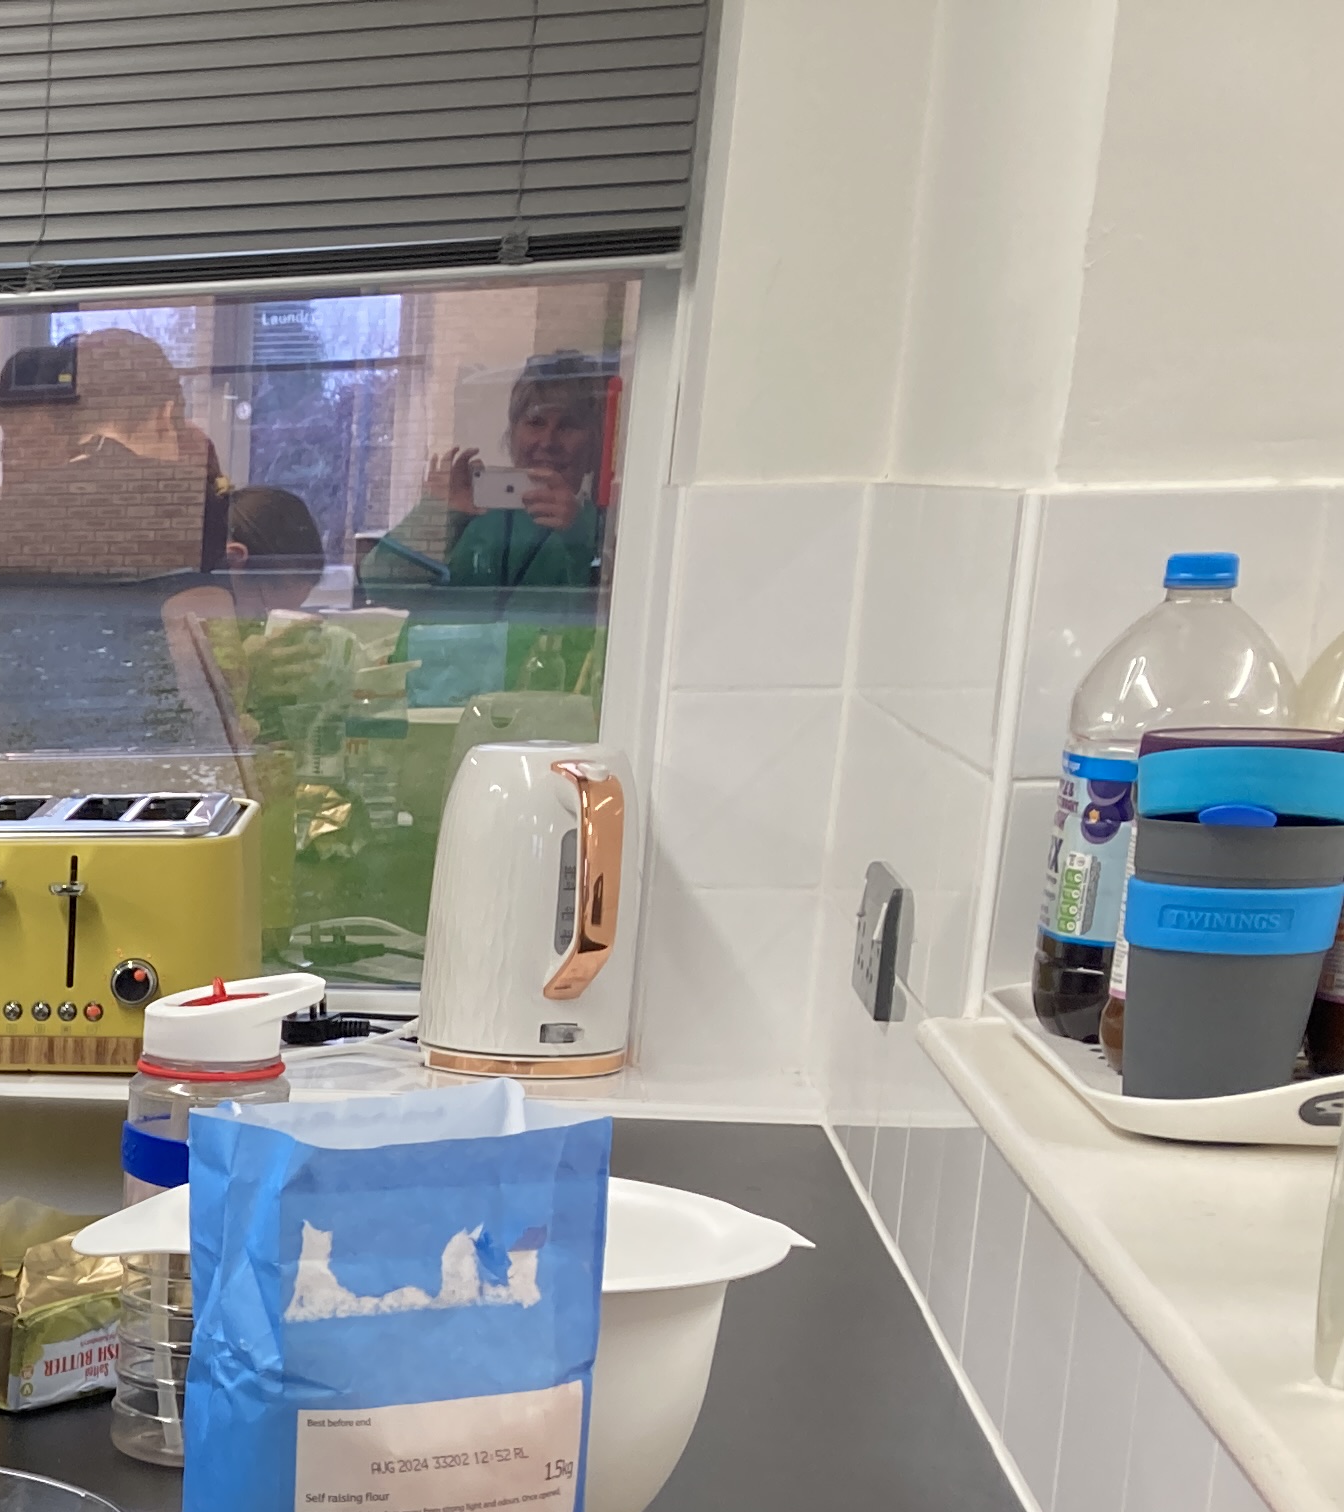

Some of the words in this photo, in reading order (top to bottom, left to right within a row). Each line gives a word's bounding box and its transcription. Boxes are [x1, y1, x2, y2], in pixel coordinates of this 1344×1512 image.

[1169, 909, 1281, 931] TWININGS
[44, 1349, 93, 1377] BUTTER
[85, 1363, 109, 1381] Salted
[307, 1418, 326, 1428] Best
[327, 1417, 354, 1428] before
[356, 1417, 372, 1427] end
[371, 1461, 395, 1474] AUG
[398, 1457, 429, 1473] 2024
[432, 1453, 470, 1470] 33202
[474, 1448, 511, 1465] 12:52
[513, 1446, 529, 1460] RL
[305, 1493, 326, 1503] Self
[328, 1493, 363, 1504] raising
[365, 1492, 390, 1502] flour
